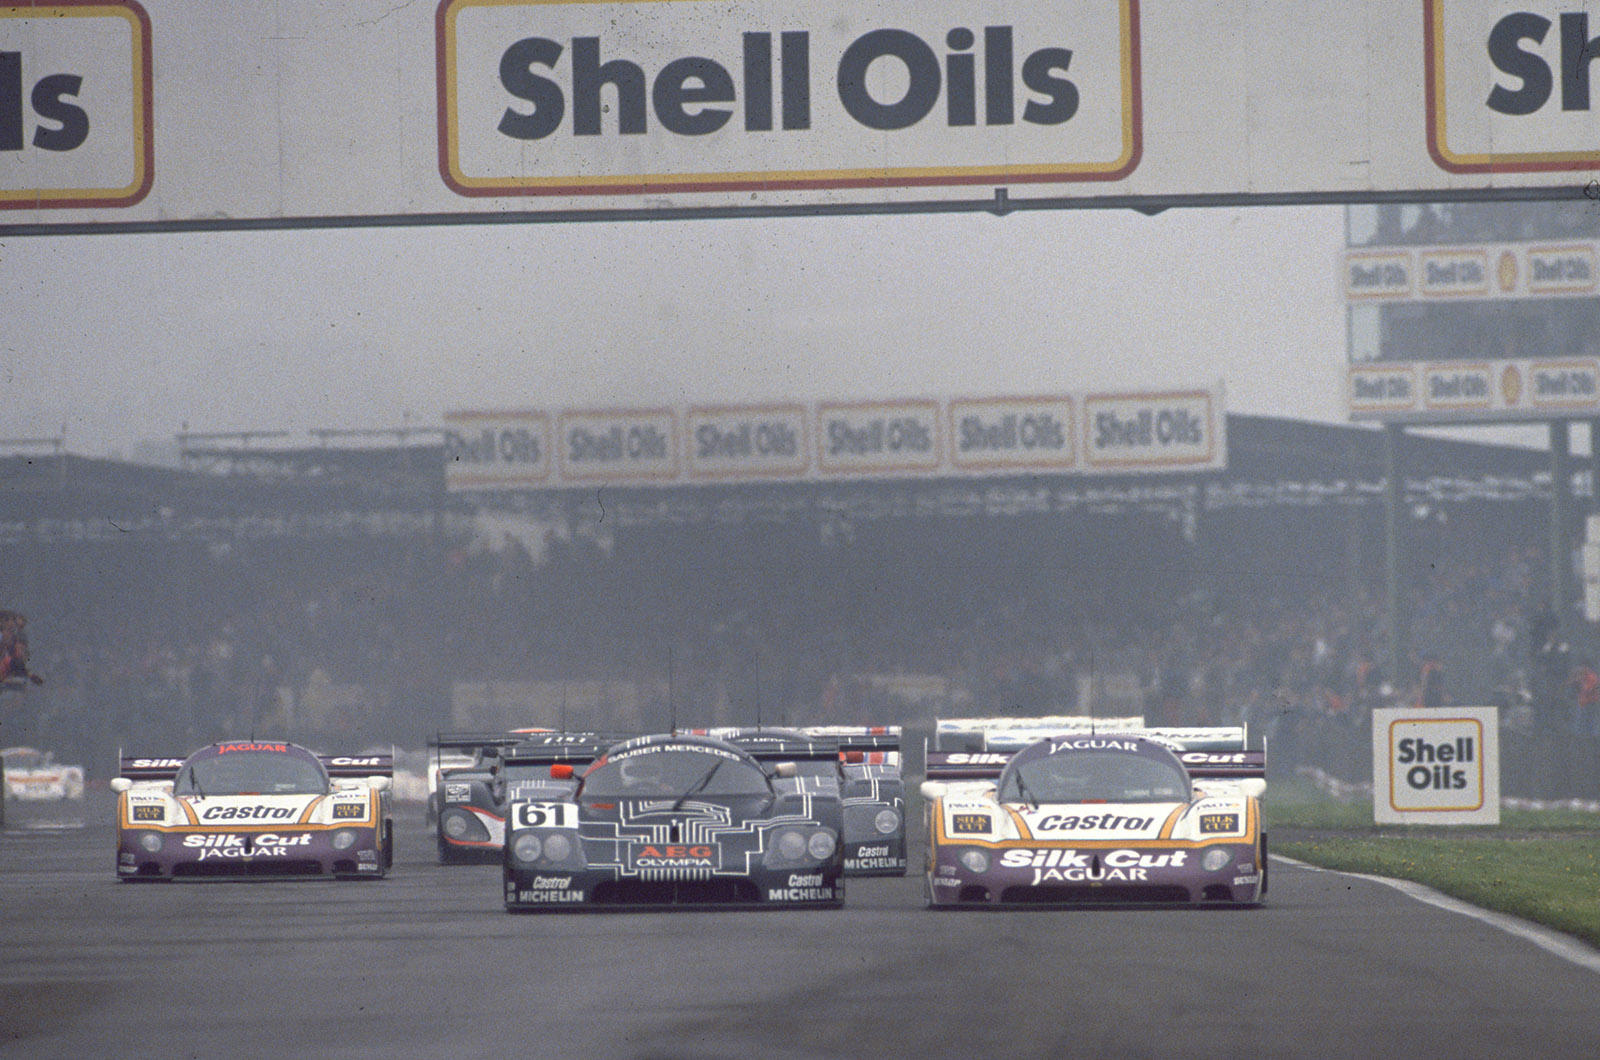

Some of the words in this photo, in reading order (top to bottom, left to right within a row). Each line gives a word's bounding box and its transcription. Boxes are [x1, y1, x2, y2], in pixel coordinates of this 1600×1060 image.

[498, 31, 809, 140] Shell
[837, 26, 1080, 130] Oils
[218, 743, 287, 755] JAGUAR
[1050, 740, 1138, 754] JAGUAR
[1398, 737, 1474, 764] Shell
[607, 745, 661, 764] SAUBER
[664, 745, 741, 762] MERCEDES
[945, 753, 1010, 764] Silk
[1181, 753, 1246, 764] Cut
[132, 759, 185, 768] Silk
[331, 757, 380, 766] Cut
[1406, 765, 1468, 790] Oils
[202, 805, 297, 820] Castrol
[518, 803, 566, 827] 61
[1037, 813, 1155, 832] Castrol
[182, 834, 244, 847] Silk
[254, 833, 313, 846] Cut
[197, 846, 288, 861] JAGUAR
[638, 845, 713, 858] AEG
[858, 846, 889, 858] Castrol
[1000, 849, 1091, 868] Silk
[1104, 849, 1189, 868] Cut
[636, 859, 712, 867] OLYMPIA
[844, 858, 898, 870] MICHELIN
[532, 875, 572, 889] Castrol
[788, 874, 823, 888] Castrol
[1030, 867, 1149, 886] JAGUAR
[519, 890, 584, 902] MICHELIN
[769, 888, 832, 901] MICHELIN
